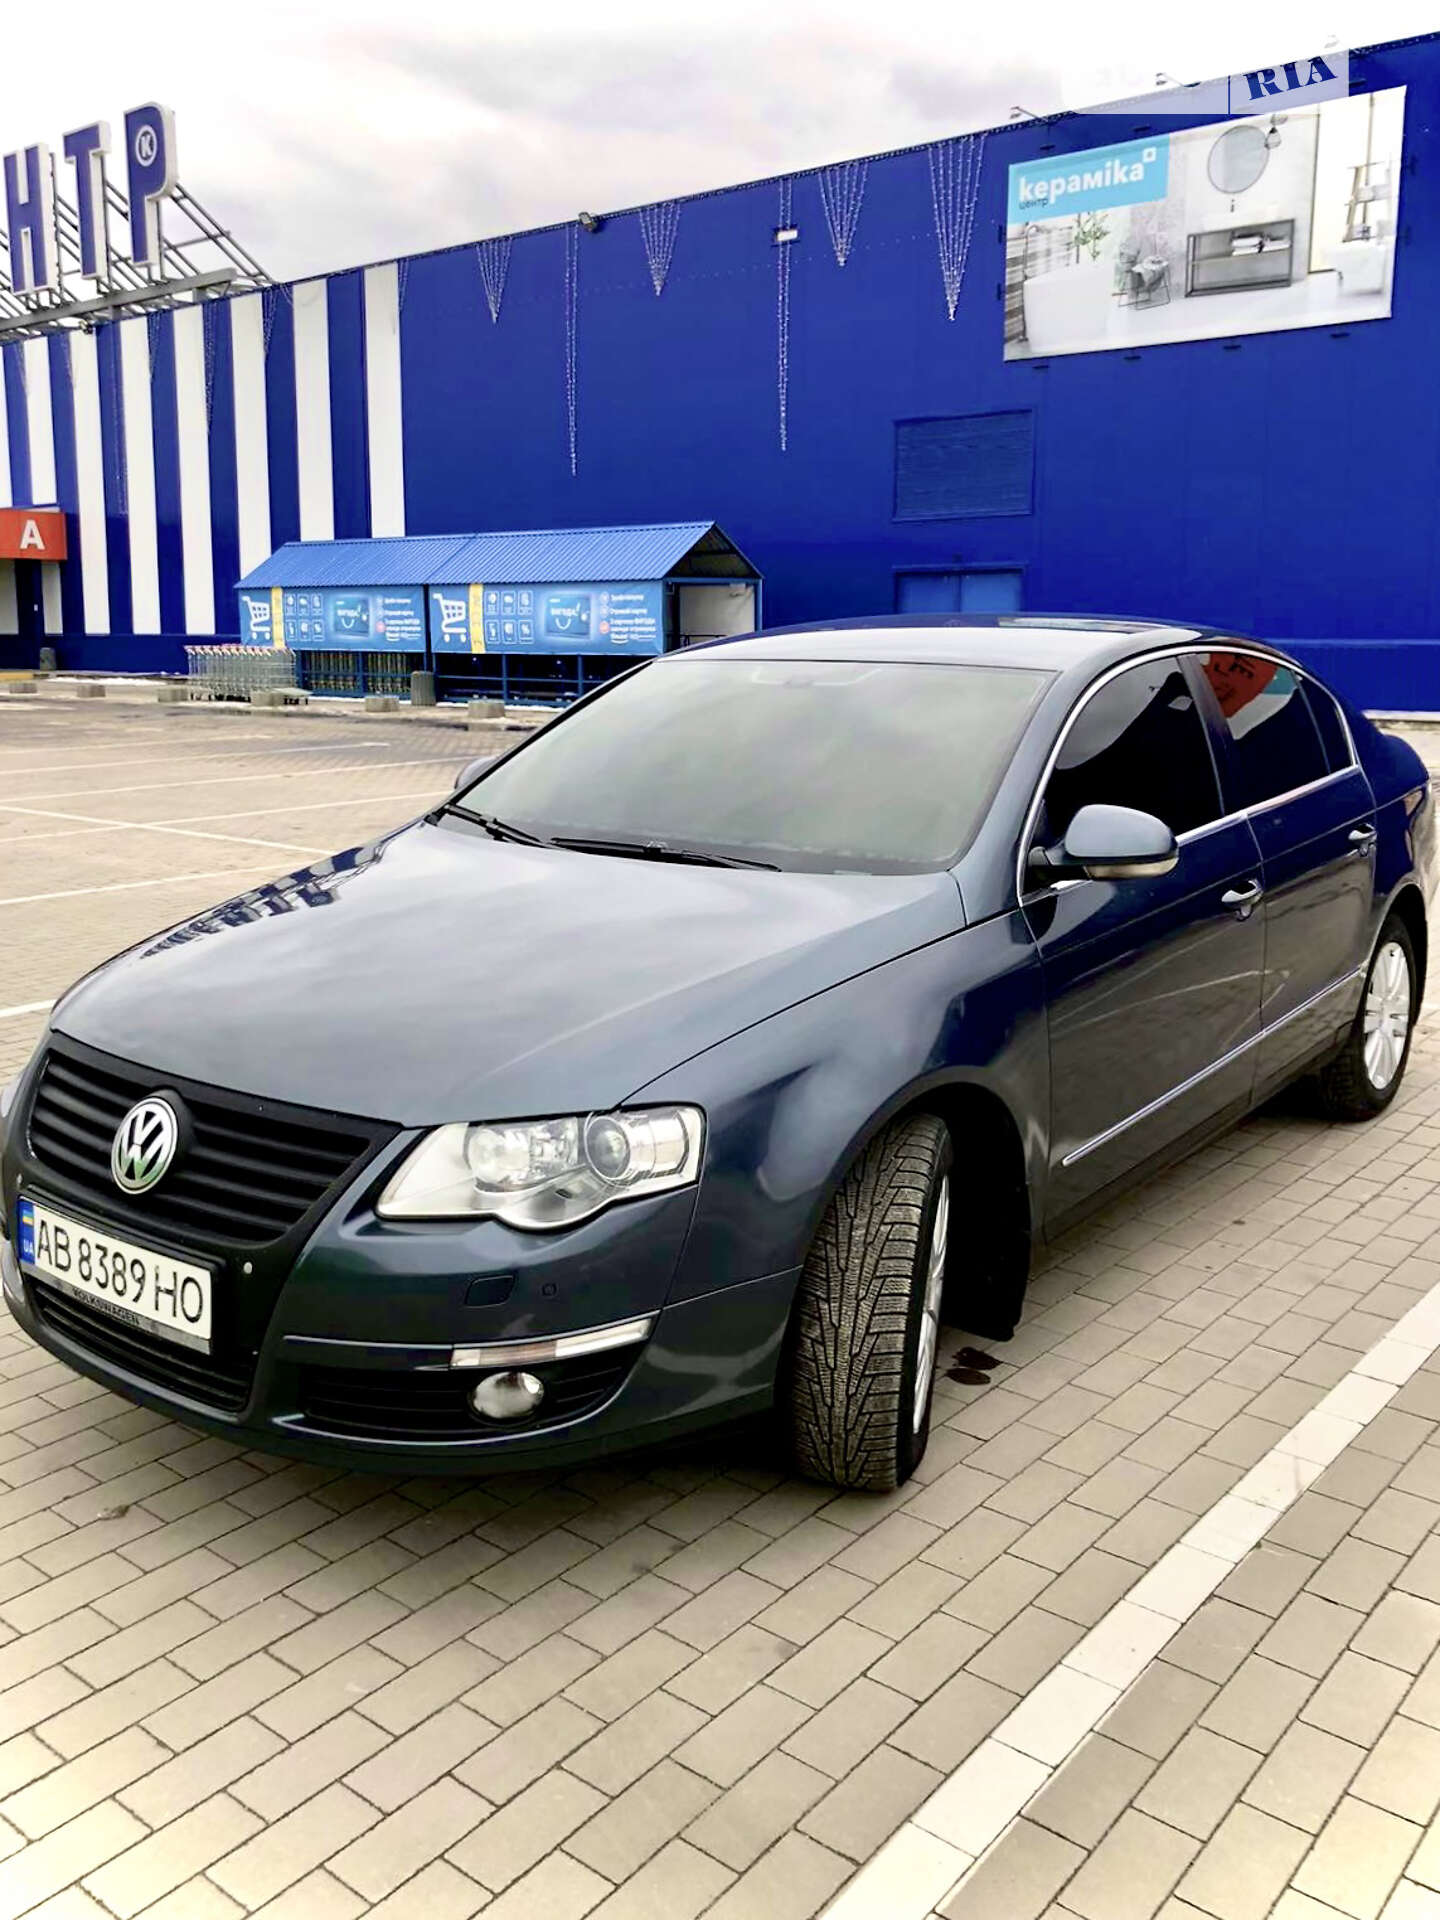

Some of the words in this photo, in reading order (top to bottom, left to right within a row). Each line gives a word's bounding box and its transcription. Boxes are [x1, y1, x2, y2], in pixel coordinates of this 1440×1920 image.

[23, 1238, 34, 1256] UA
[37, 1219, 71, 1272] AB
[78, 1238, 146, 1303] 8389
